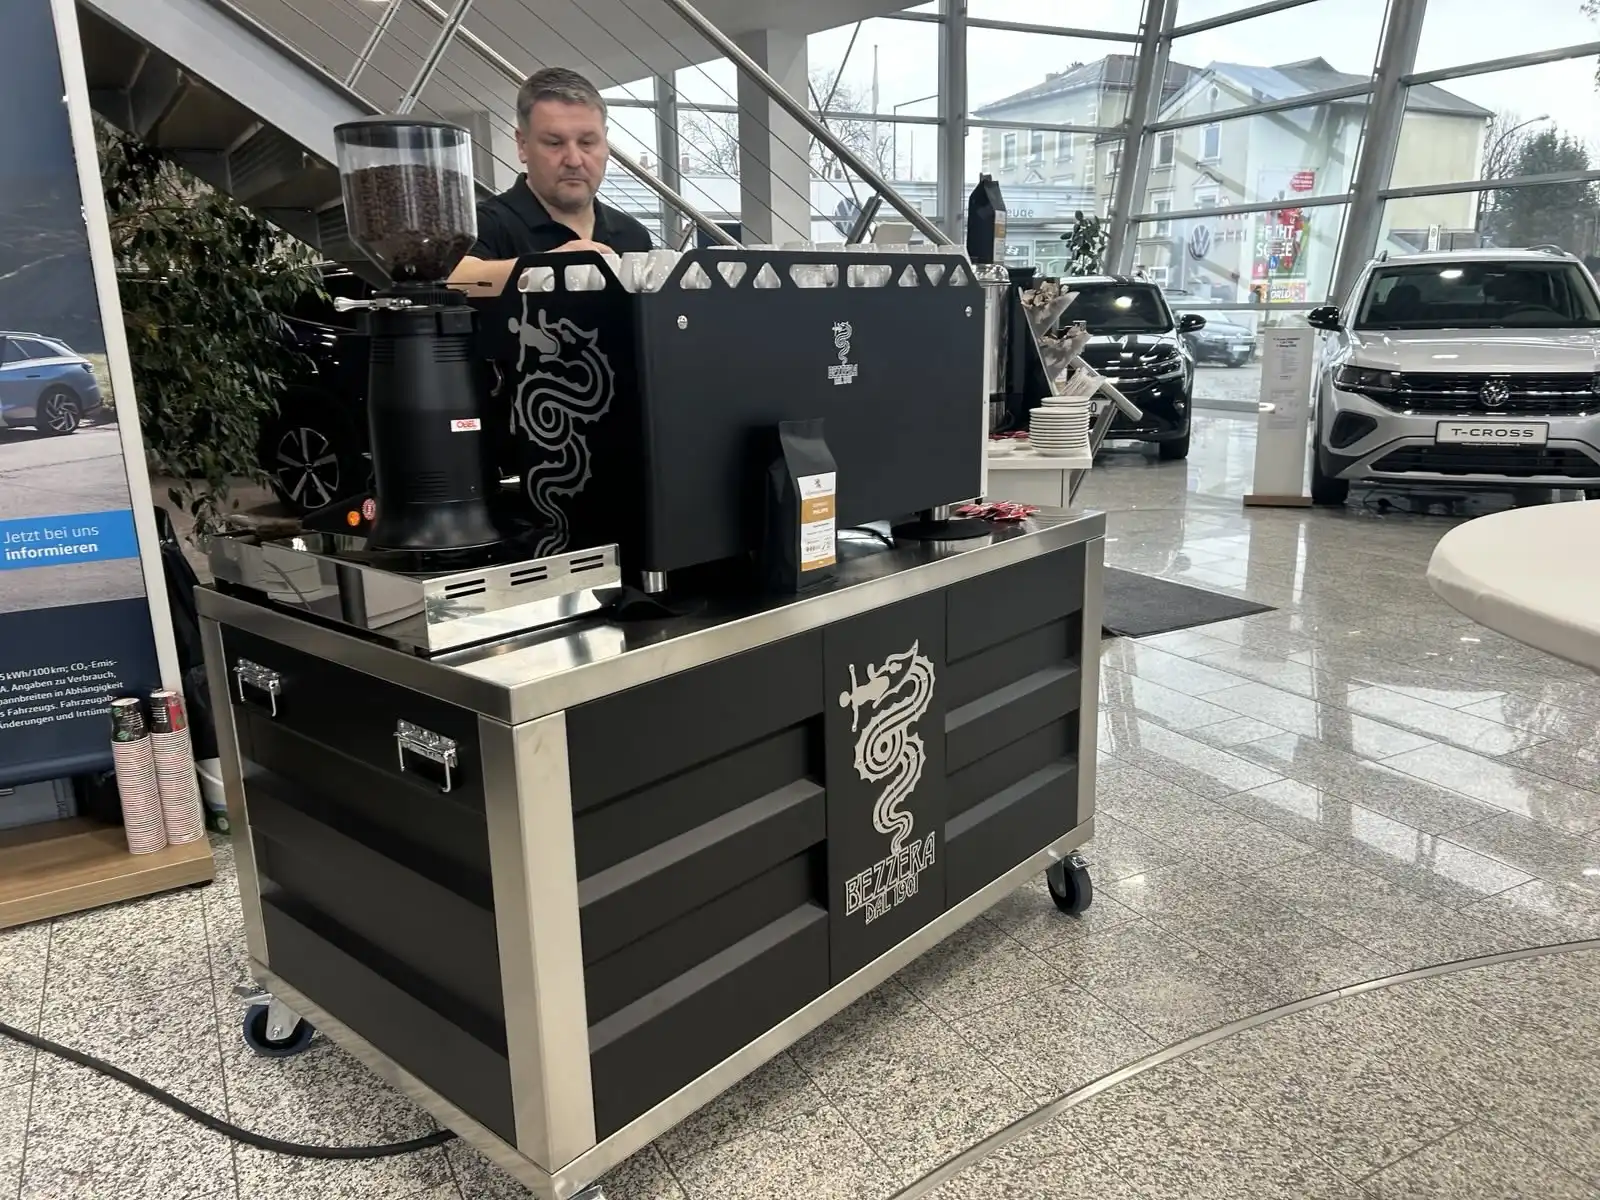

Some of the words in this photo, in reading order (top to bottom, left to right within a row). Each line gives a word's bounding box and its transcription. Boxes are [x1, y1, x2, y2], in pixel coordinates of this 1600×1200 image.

[1451, 428, 1535, 438] T-CROSS
[3, 531, 41, 544] Jetzt
[44, 526, 68, 540] bei
[72, 526, 99, 538] uns
[4, 543, 98, 560] informieren
[11, 680, 53, 691] Angaben
[67, 671, 117, 683] Verbrauch,
[54, 689, 64, 697] in
[65, 682, 124, 695] Abhängigkeit
[7, 704, 59, 716] Fahrzeugs.
[60, 695, 117, 708] Fahrzeugab-
[56, 713, 74, 721] und
[76, 708, 112, 717] Irrtüme
[845, 831, 935, 916] BEZZERA
[865, 893, 891, 925] DAL
[893, 874, 919, 907] 1901
